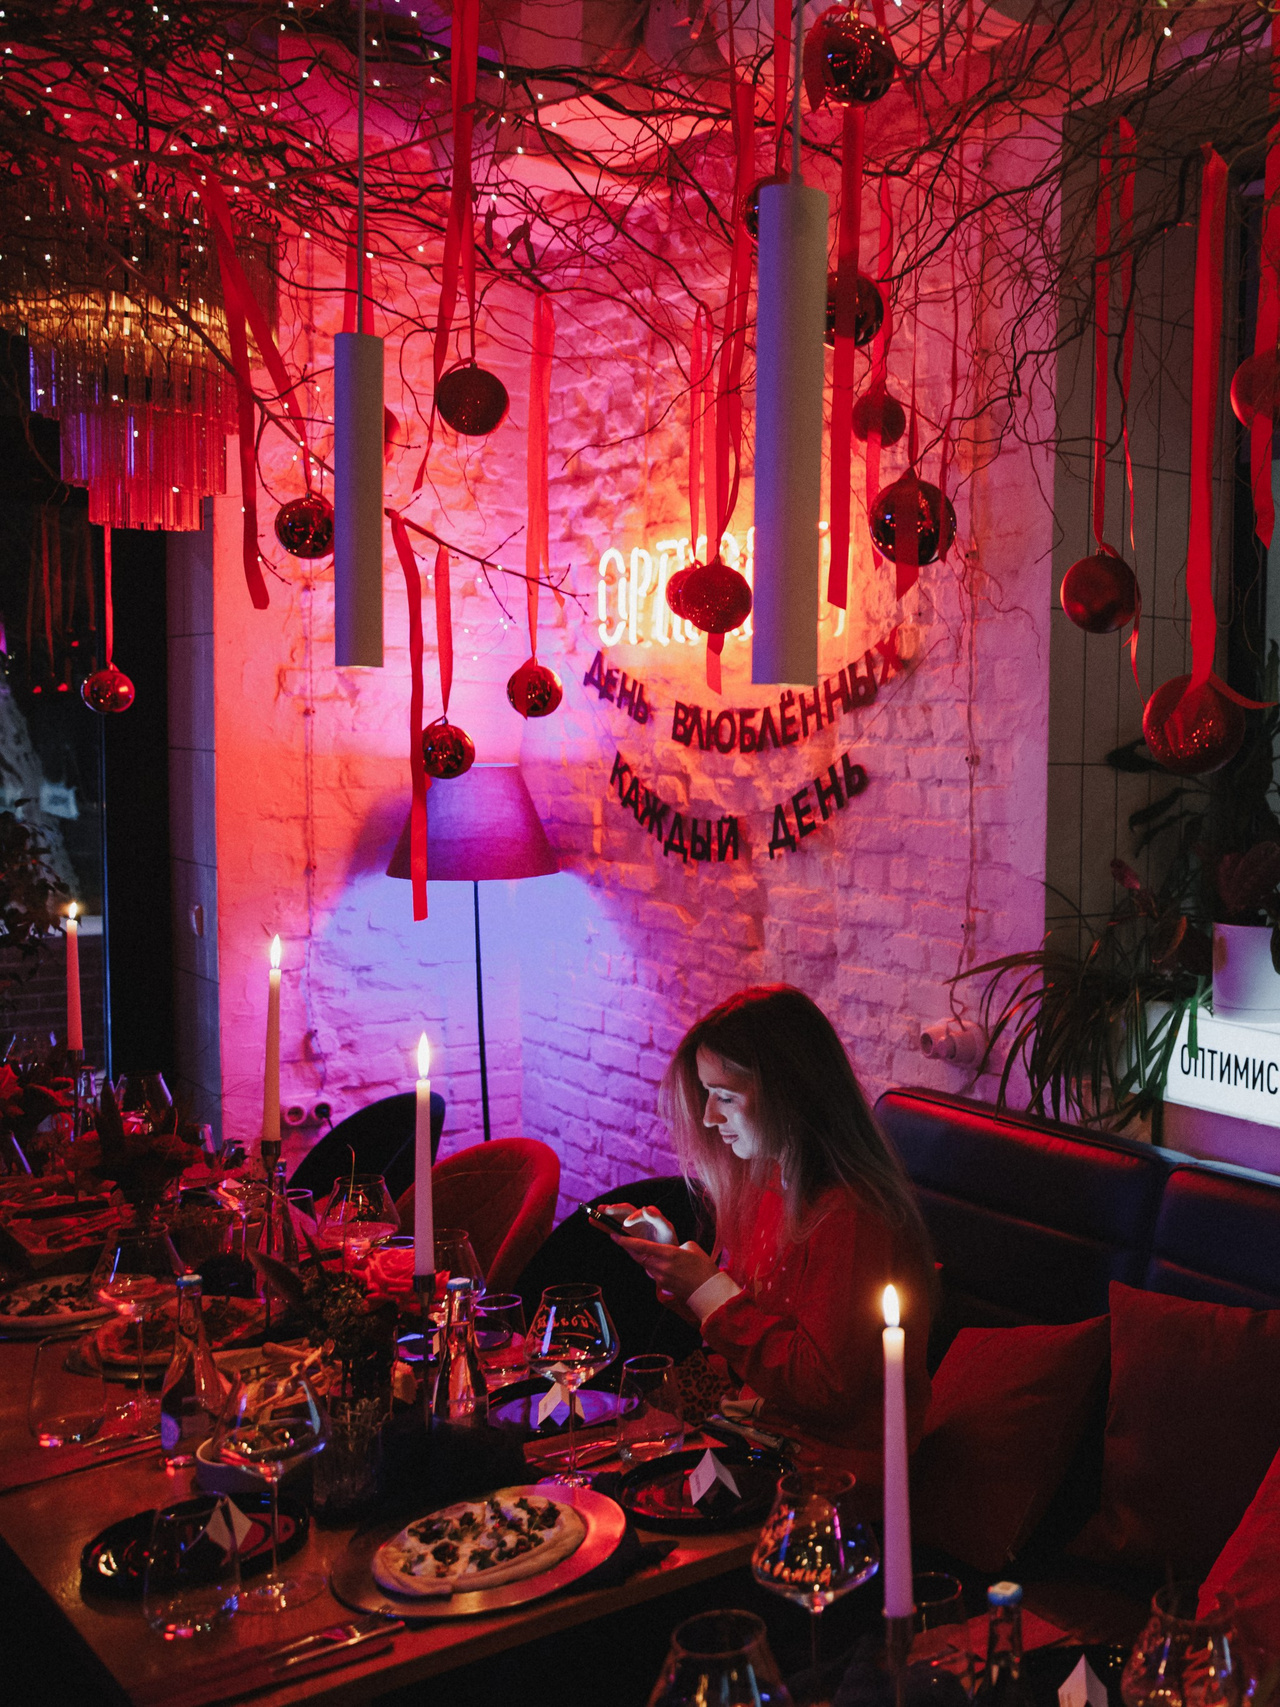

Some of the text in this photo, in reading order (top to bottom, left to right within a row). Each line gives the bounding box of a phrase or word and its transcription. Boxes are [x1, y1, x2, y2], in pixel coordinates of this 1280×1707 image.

[583, 627, 904, 754] ДЕНЬ ВЛЮБЛЁННЫХ
[610, 751, 869, 863] КАЖДЫЙ ДЕНЬ
